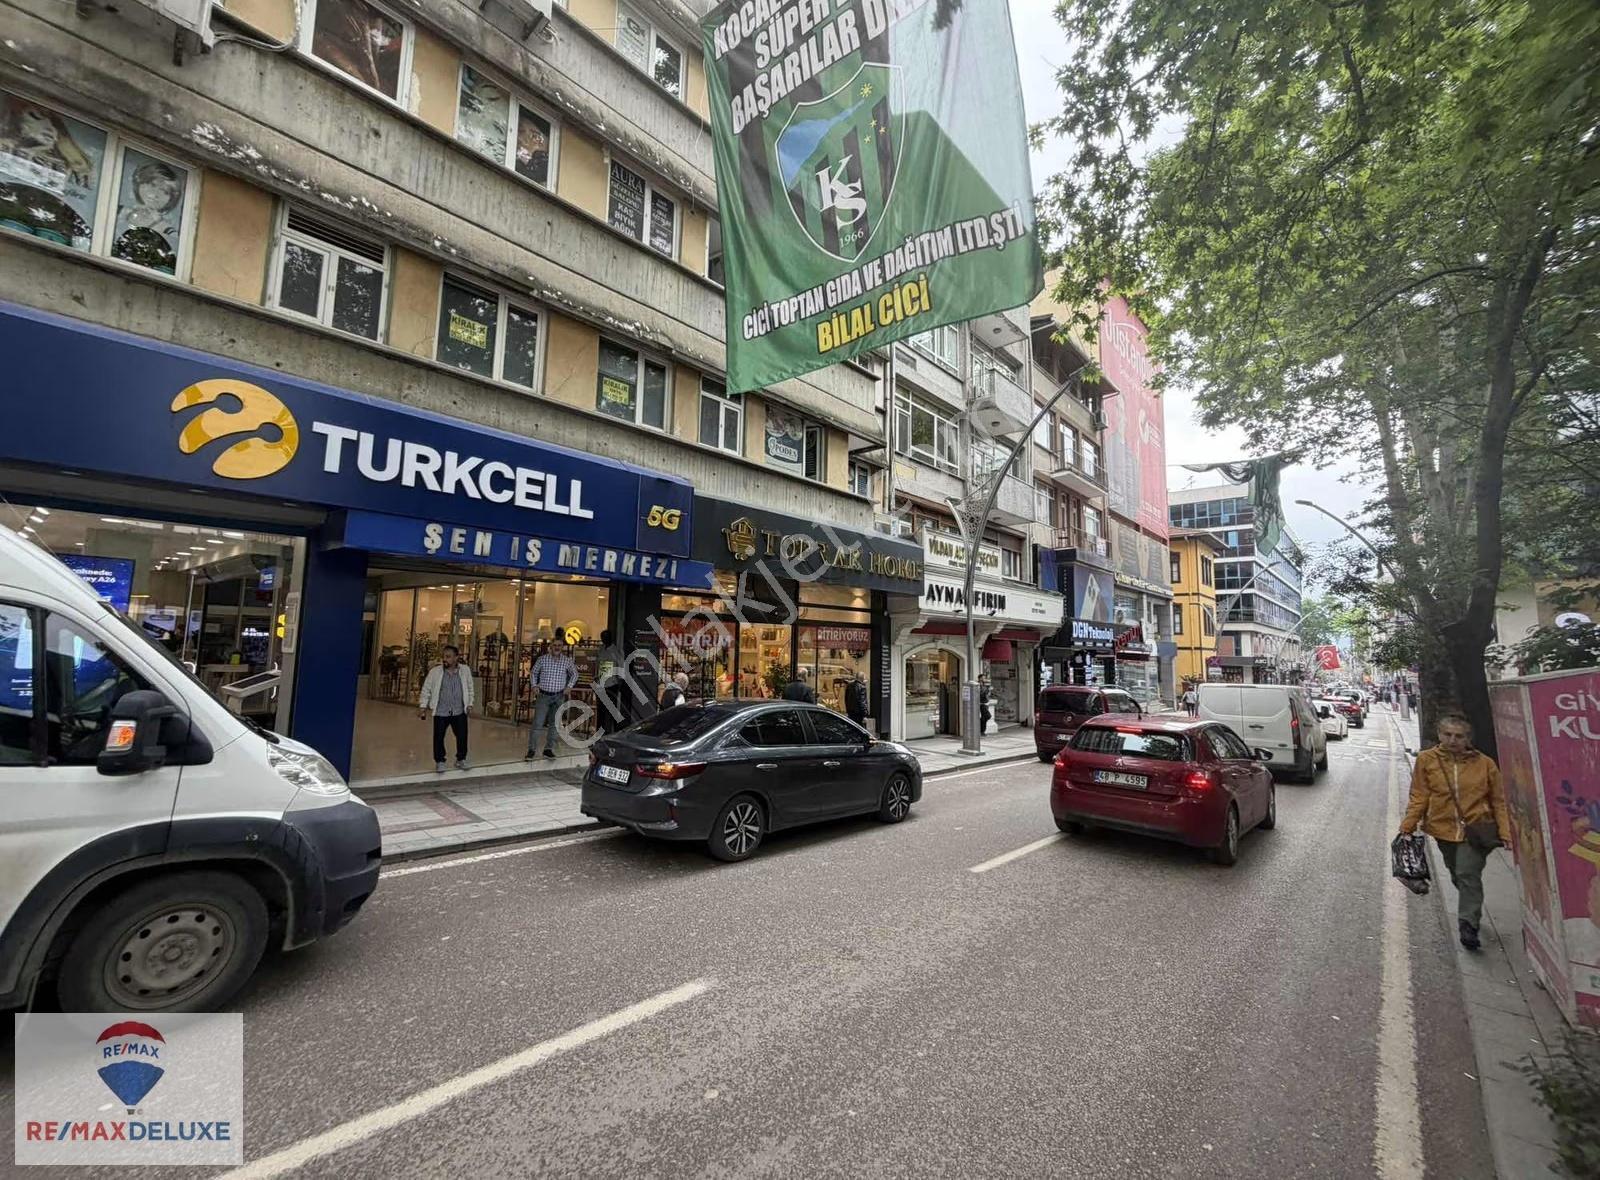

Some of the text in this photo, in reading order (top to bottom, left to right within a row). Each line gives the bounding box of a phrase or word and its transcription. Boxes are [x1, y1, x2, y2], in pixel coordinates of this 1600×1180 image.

[755, 0, 830, 69] SÜPER
[731, 9, 861, 134] BAŞARILAR
[611, 164, 644, 194] AURA
[840, 228, 864, 248] 1966
[743, 303, 771, 340] CİCİ
[770, 285, 825, 328] TOPTAN
[826, 268, 863, 307] GIDA
[862, 256, 886, 292] VE
[884, 225, 955, 281] DAĞITIM
[817, 273, 932, 354] BİLAL CİCİ
[311, 420, 594, 519] TURKCELL
[424, 523, 492, 555] ŞEN
[647, 505, 682, 531] 5G
[1114, 773, 1120, 781] P
